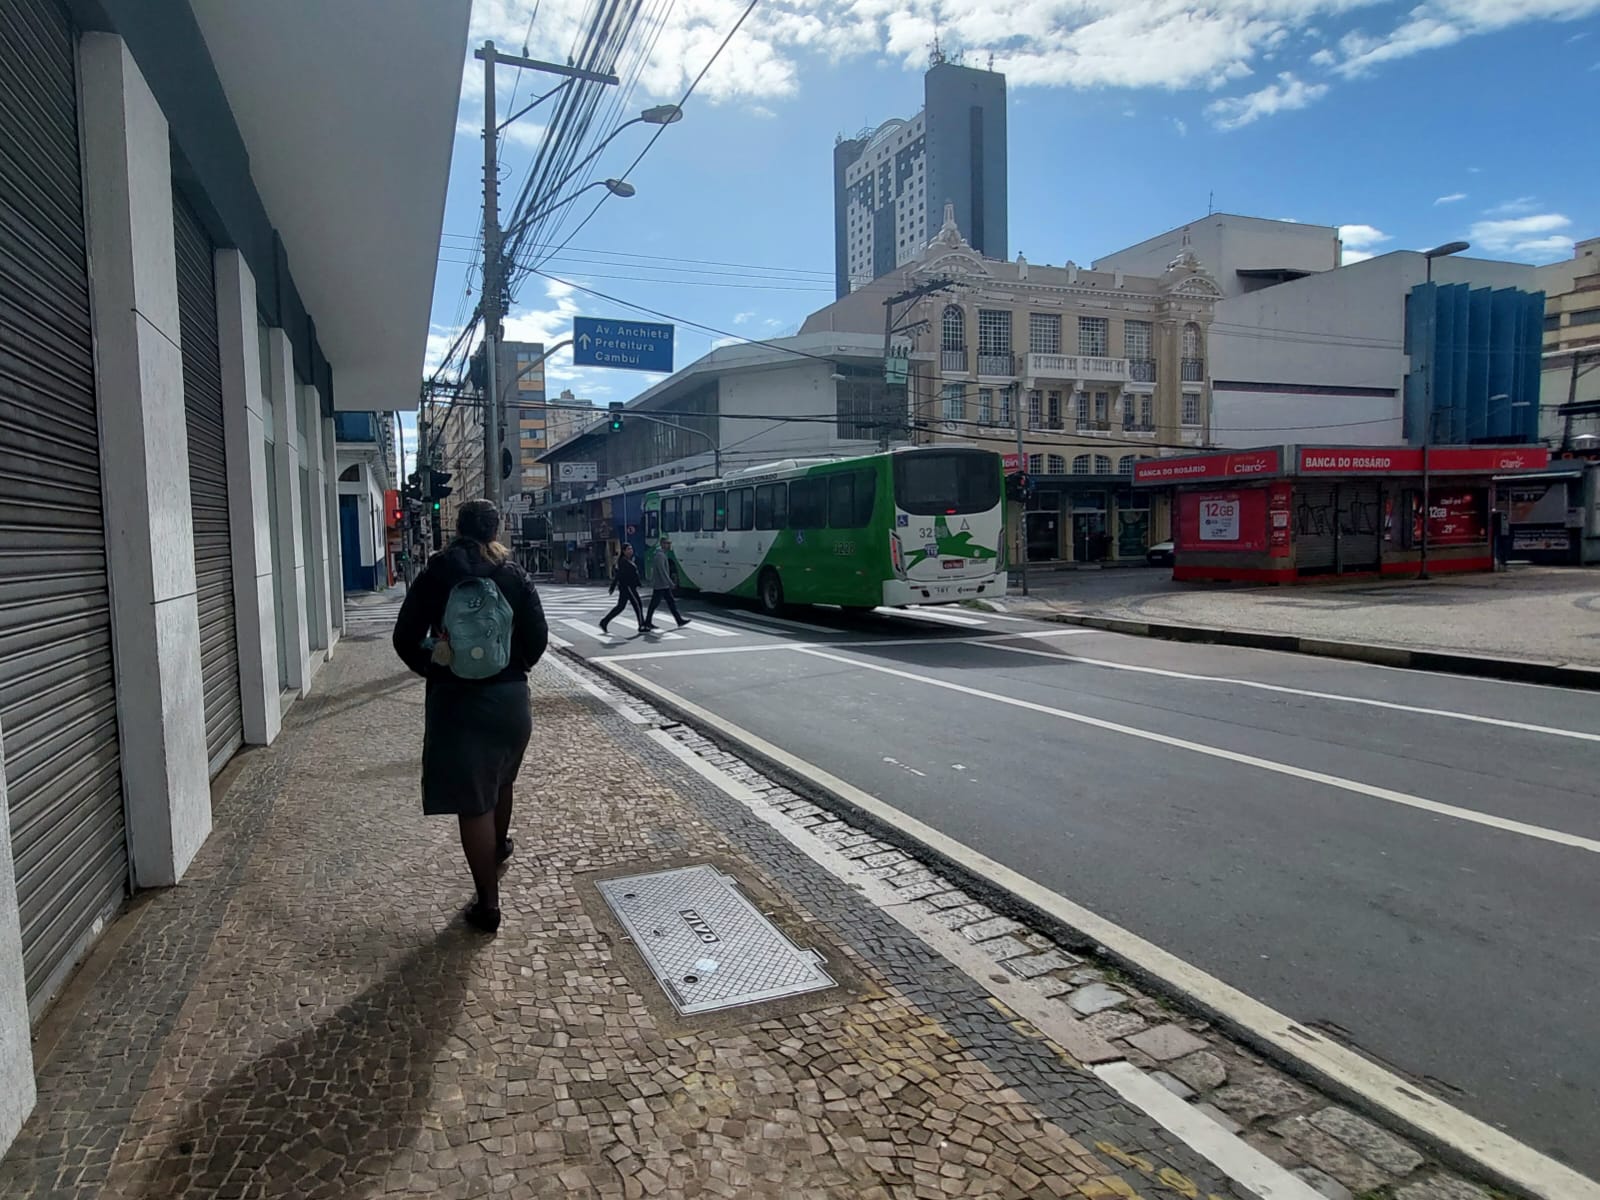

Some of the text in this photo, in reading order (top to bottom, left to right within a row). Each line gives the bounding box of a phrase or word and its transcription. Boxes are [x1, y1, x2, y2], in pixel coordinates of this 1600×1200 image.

[596, 324, 669, 339] Av. Anchieta
[595, 338, 655, 352] Prefeitura
[1234, 462, 1262, 473] Claro
[1305, 455, 1391, 468] BANCA DO ROSÁRIO
[1500, 458, 1521, 469] Claro
[1138, 467, 1161, 477] BANCA
[1162, 467, 1173, 475] DO
[1205, 503, 1234, 517] 12GB
[683, 911, 717, 942] VIVO
